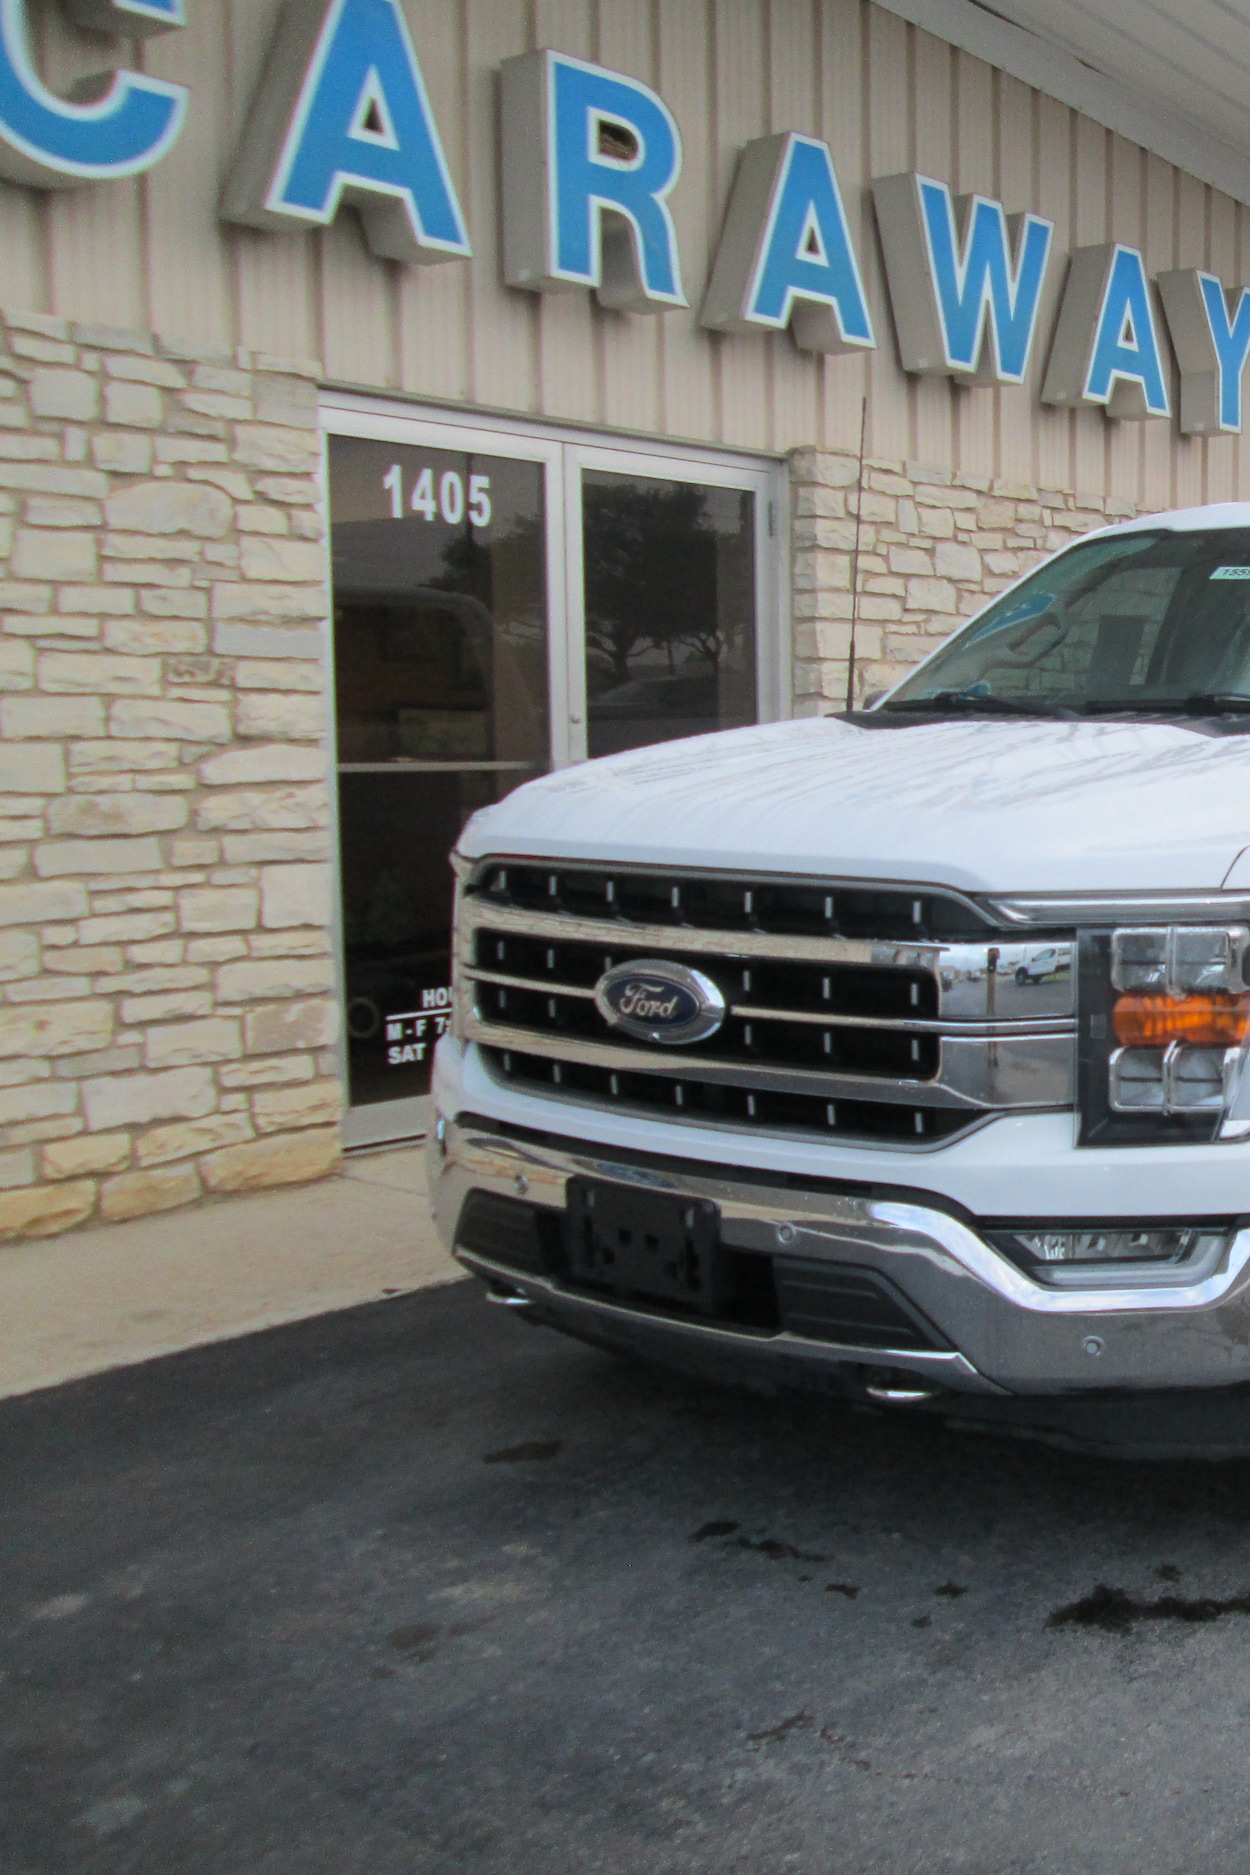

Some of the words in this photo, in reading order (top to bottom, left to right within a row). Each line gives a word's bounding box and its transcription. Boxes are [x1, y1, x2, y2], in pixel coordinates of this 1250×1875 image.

[383, 464, 492, 528] 1405
[618, 982, 679, 1019] Ford
[387, 1042, 427, 1065] SAT
